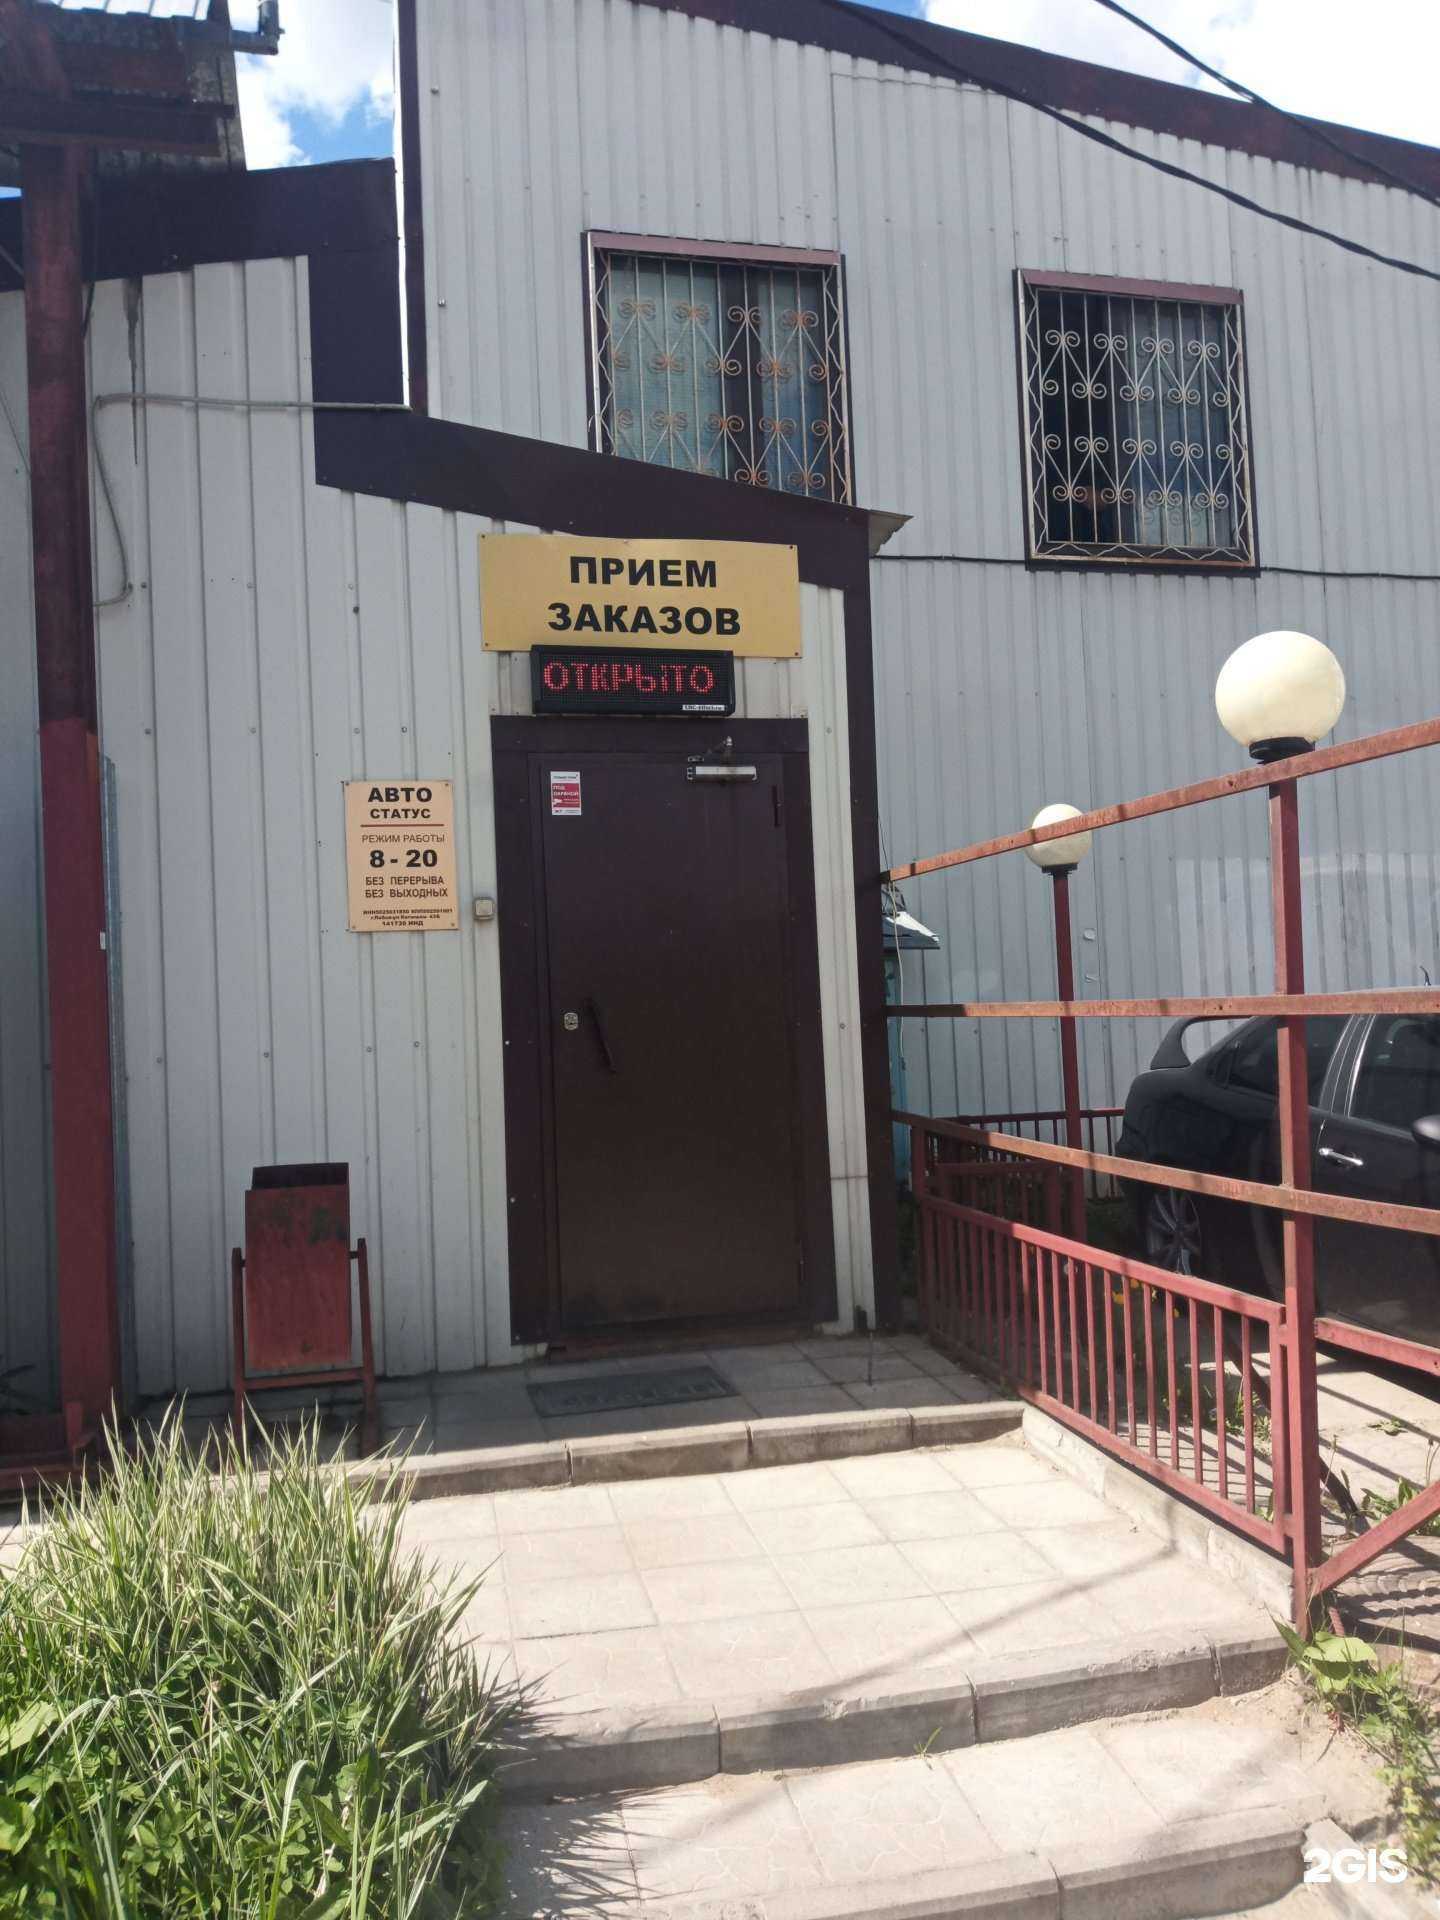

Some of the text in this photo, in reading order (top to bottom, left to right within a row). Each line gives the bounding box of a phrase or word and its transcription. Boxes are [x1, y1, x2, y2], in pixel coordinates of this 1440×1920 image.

[570, 556, 717, 588] ПРИЕМ
[548, 602, 741, 635] ЗАКАЗОВ
[543, 661, 715, 694] ОТКРЫТО
[367, 787, 433, 803] АВТО
[369, 808, 431, 819] СТАТУС
[361, 833, 445, 843] РЕЖИМ РАБОТЫ
[369, 849, 385, 868] 8
[405, 849, 438, 868] 20
[365, 875, 445, 886] БЕЗ ПЕРЕРЫВА
[365, 888, 448, 899] БЕЗ ВЫХОДНЫХ
